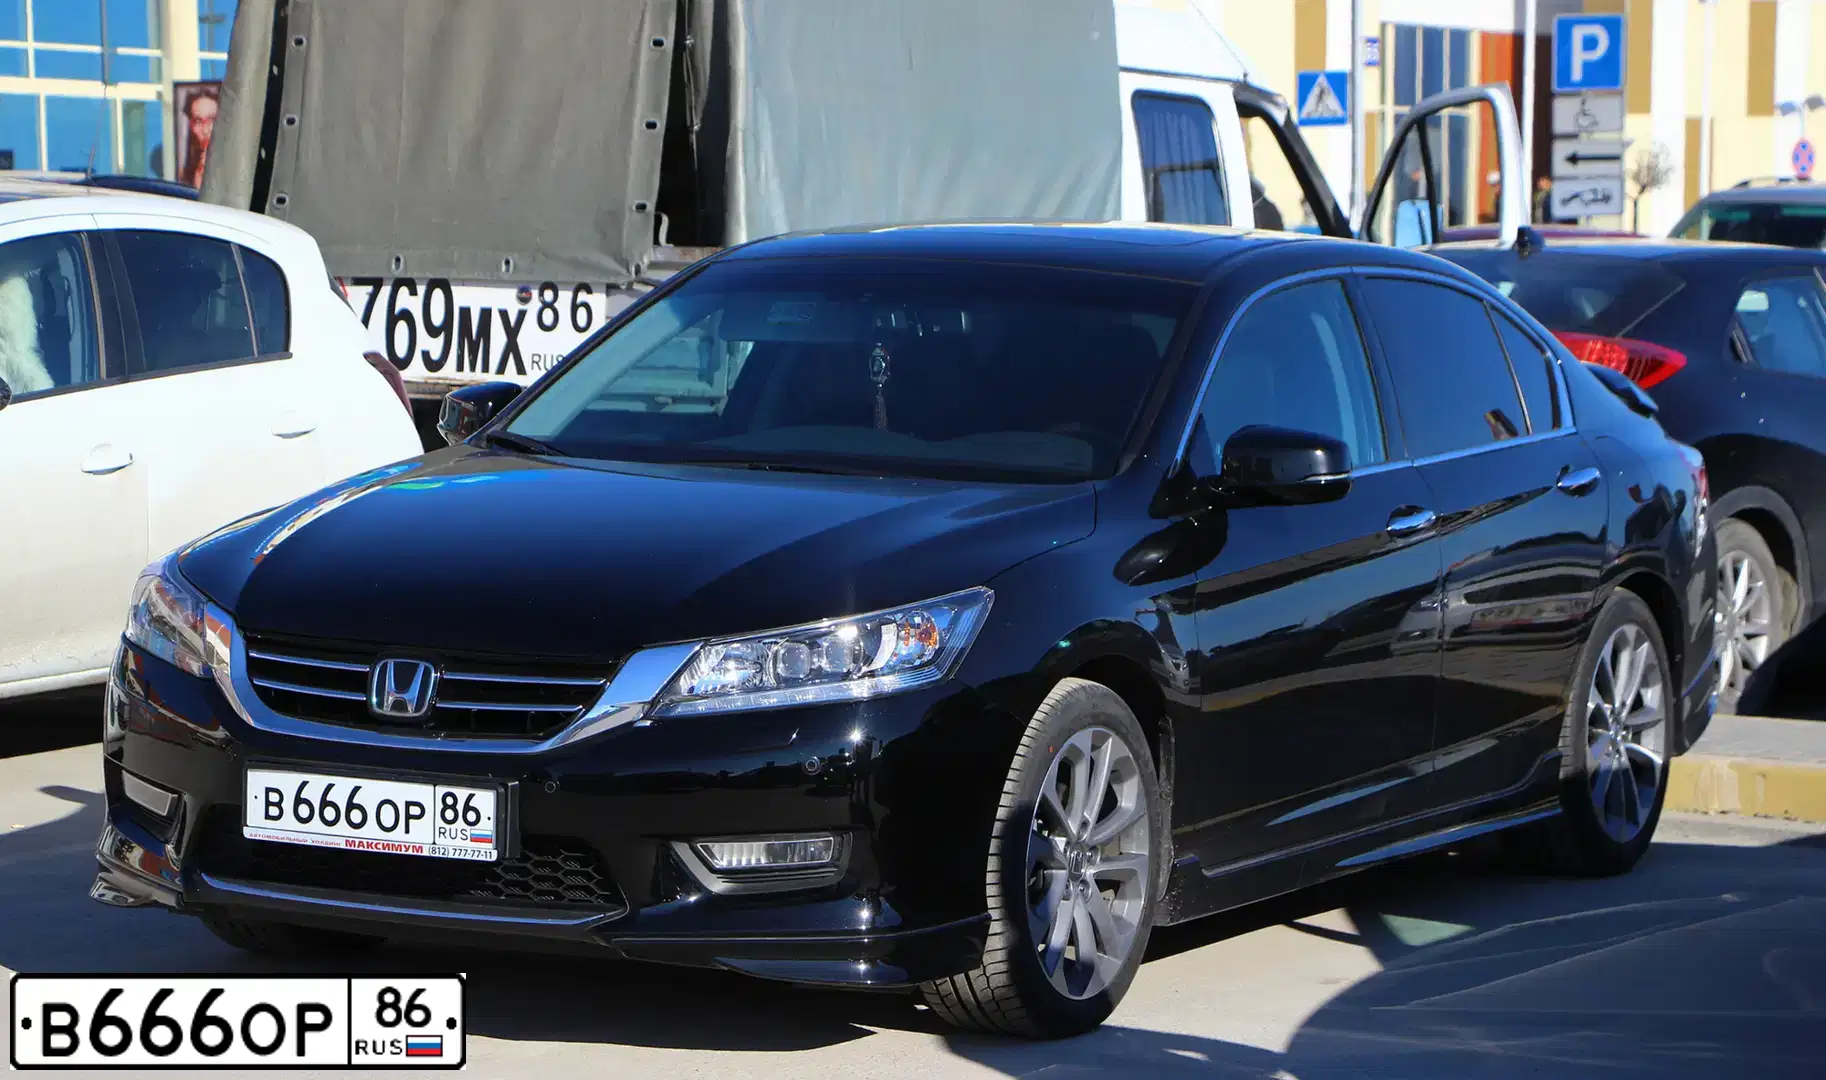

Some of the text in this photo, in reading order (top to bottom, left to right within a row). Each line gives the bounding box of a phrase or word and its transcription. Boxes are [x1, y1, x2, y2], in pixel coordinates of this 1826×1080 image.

[1571, 24, 1610, 82] P
[536, 281, 593, 333] 86
[440, 791, 481, 826] 86
[344, 838, 424, 854] МАКСИМУМ
[428, 846, 450, 858] (812)
[451, 847, 493, 860] 777-77-11
[438, 827, 469, 841] RUS
